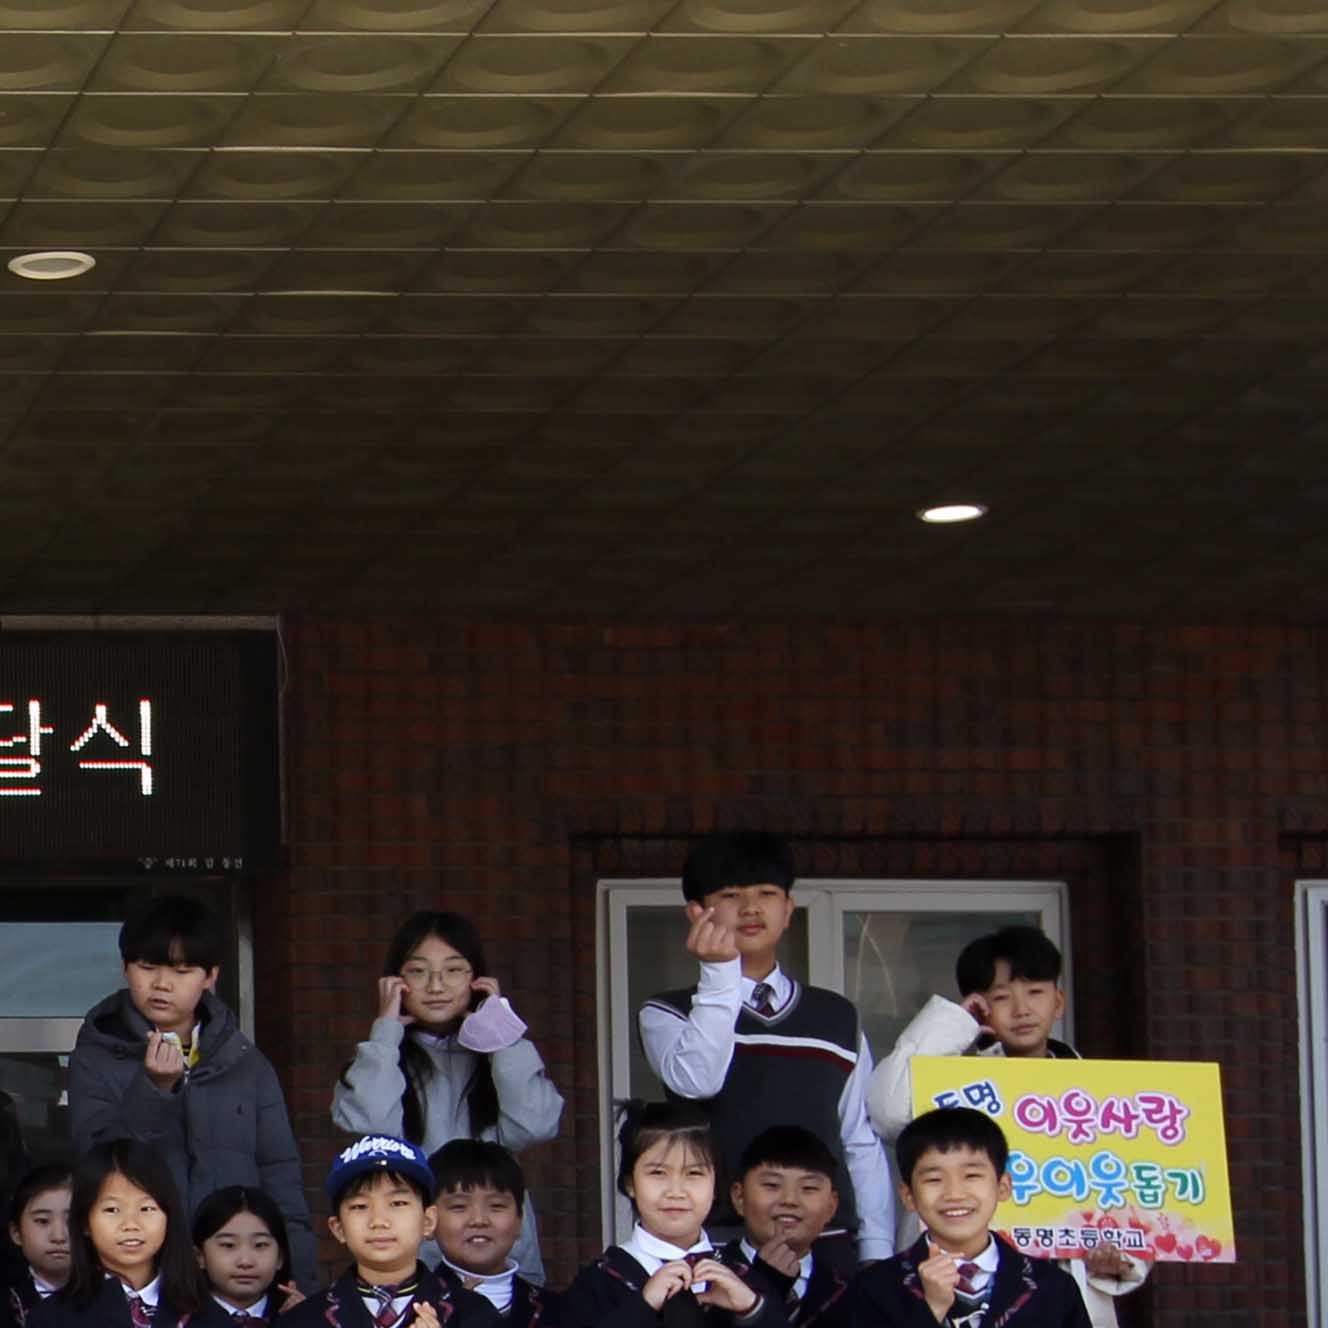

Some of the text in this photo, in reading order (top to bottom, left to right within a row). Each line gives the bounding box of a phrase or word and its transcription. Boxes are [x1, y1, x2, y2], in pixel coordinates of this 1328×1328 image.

[1015, 1091, 1191, 1145] 이웃사랑
[1007, 1151, 1204, 1210] 우이웃돕기
[1013, 1228, 1145, 1250] 동명초등학교
